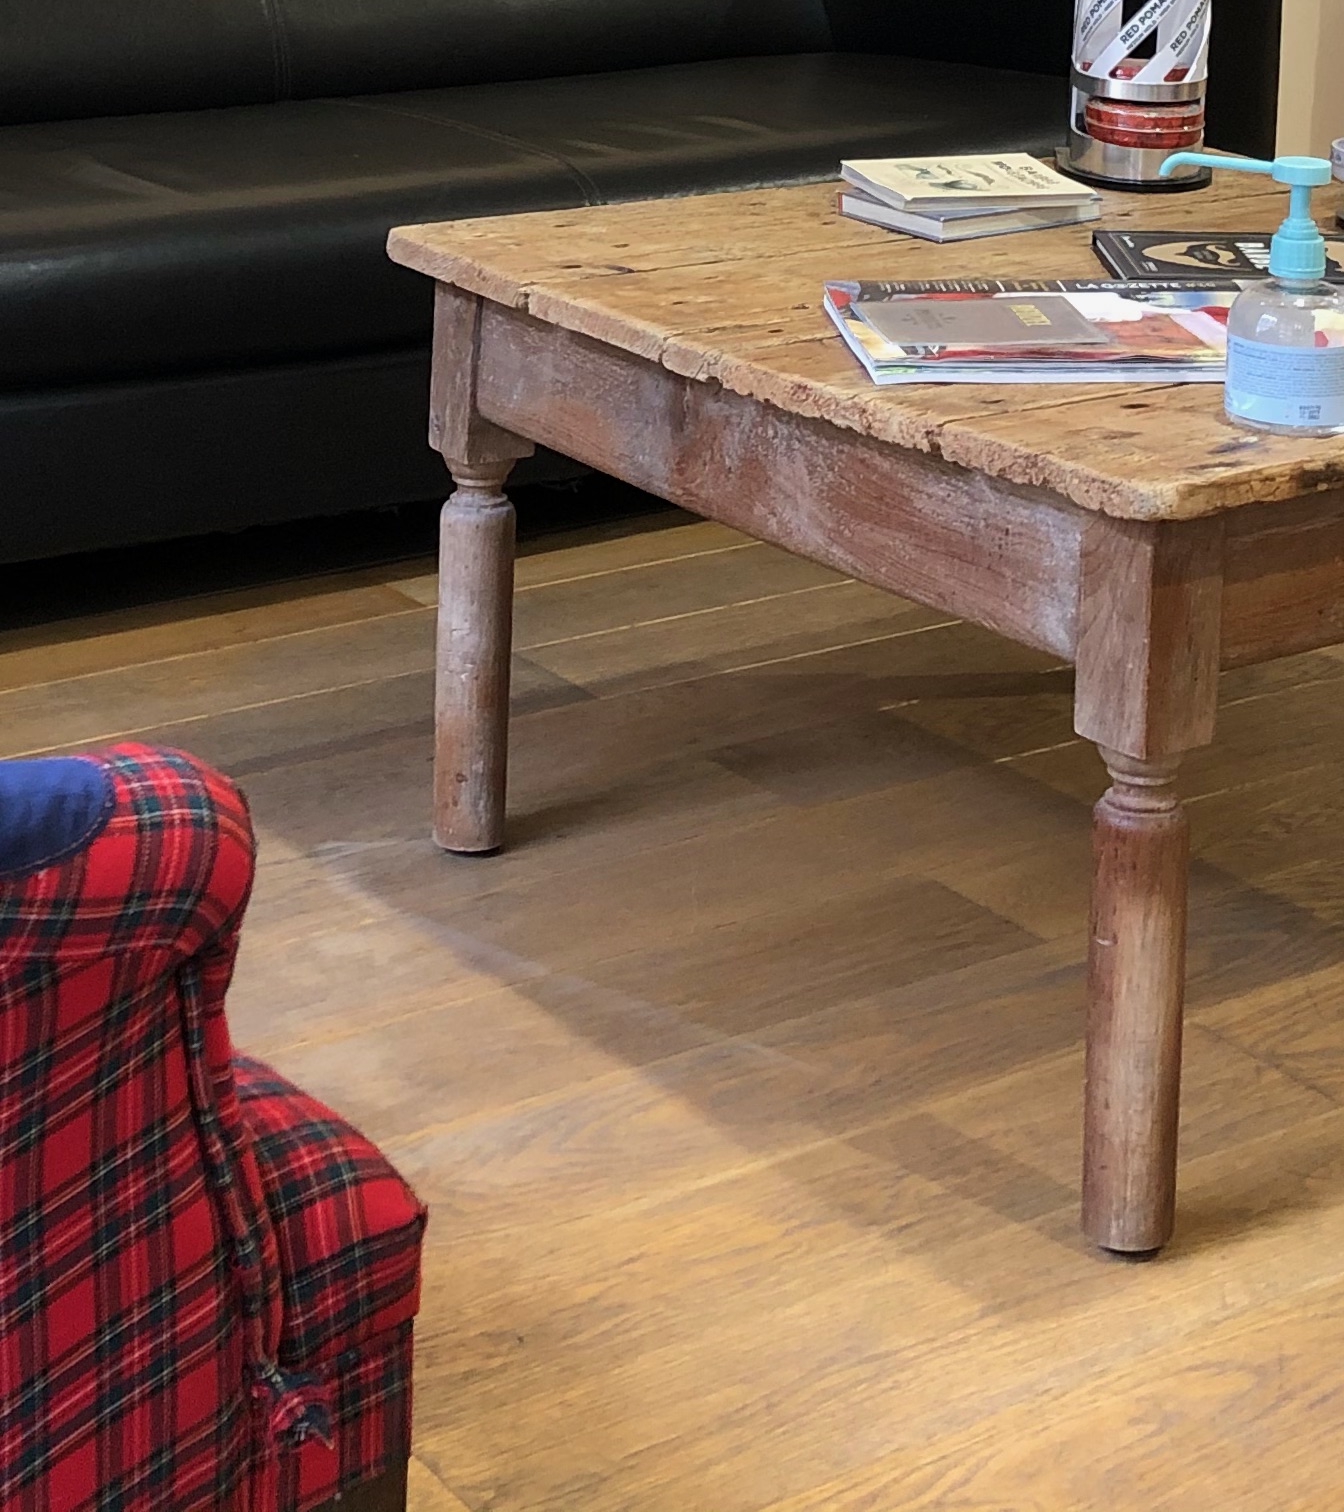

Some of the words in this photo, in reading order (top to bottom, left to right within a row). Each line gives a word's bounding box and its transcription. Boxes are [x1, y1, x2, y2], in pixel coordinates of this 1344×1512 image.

[1080, 15, 1092, 35] RED
[1119, 23, 1139, 46] RED
[1170, 29, 1187, 51] RED
